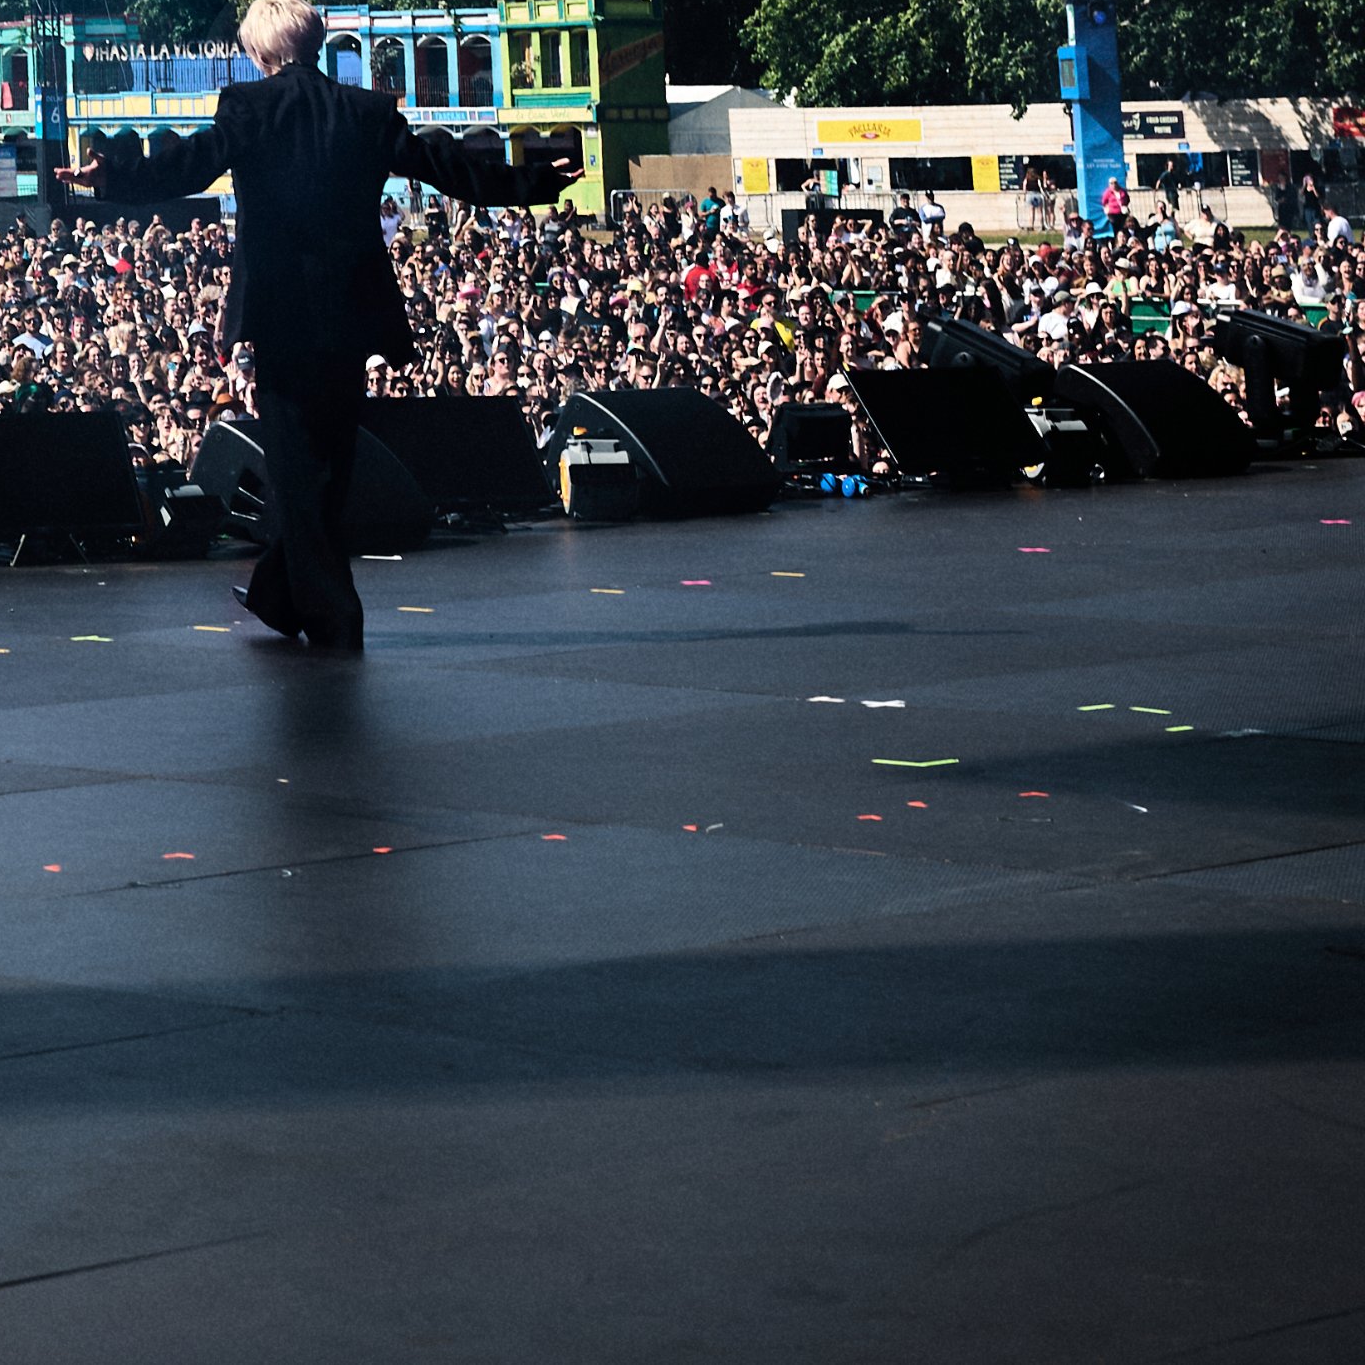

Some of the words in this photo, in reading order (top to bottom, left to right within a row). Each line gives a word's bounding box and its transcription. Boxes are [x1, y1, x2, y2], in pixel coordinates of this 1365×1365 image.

[150, 42, 170, 61] LA
[173, 39, 241, 60] VICTORIA
[51, 106, 60, 124] 6
